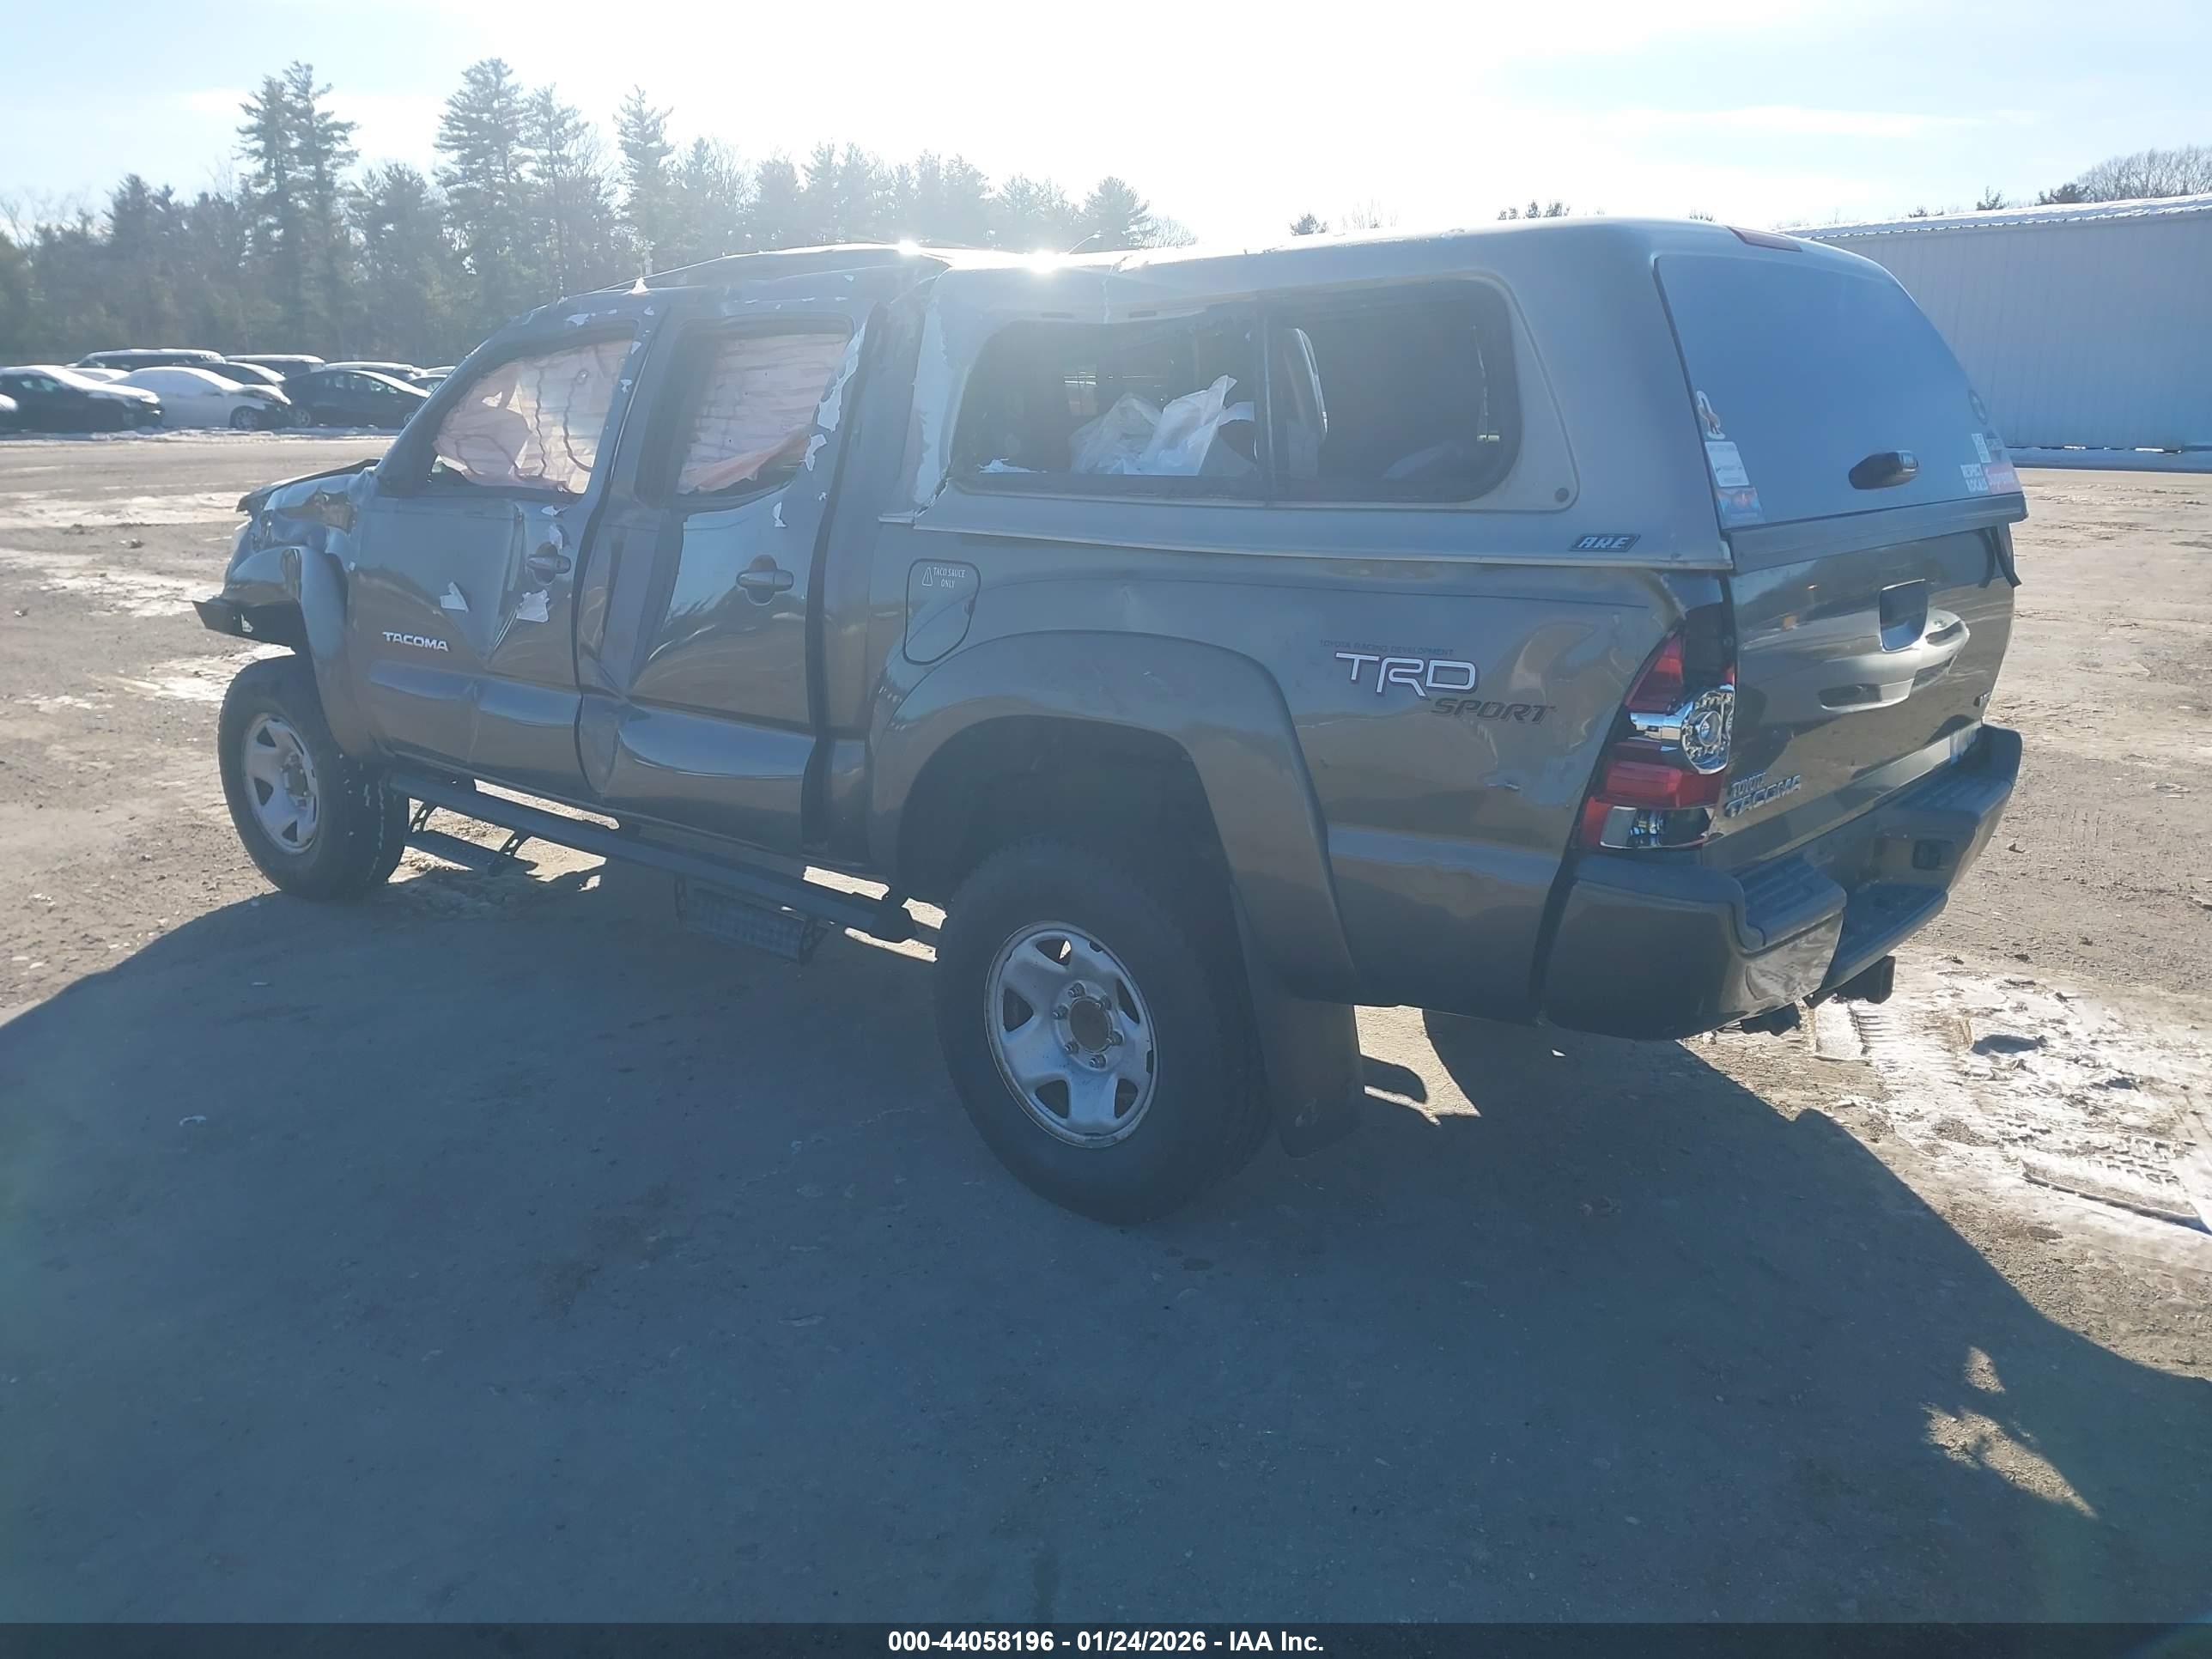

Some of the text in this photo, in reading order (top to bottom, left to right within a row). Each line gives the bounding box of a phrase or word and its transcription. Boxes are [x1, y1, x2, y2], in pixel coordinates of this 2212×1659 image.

[933, 567, 966, 578] TACO SAUCE
[940, 578, 955, 589] ONLY
[382, 631, 449, 653] TACOMA
[1319, 639, 1455, 656] TOYOTA RACING DEVELOPMENT
[1334, 651, 1478, 698] TRD
[1430, 696, 1558, 724] SPORT
[1724, 775, 1802, 817] TACOMA
